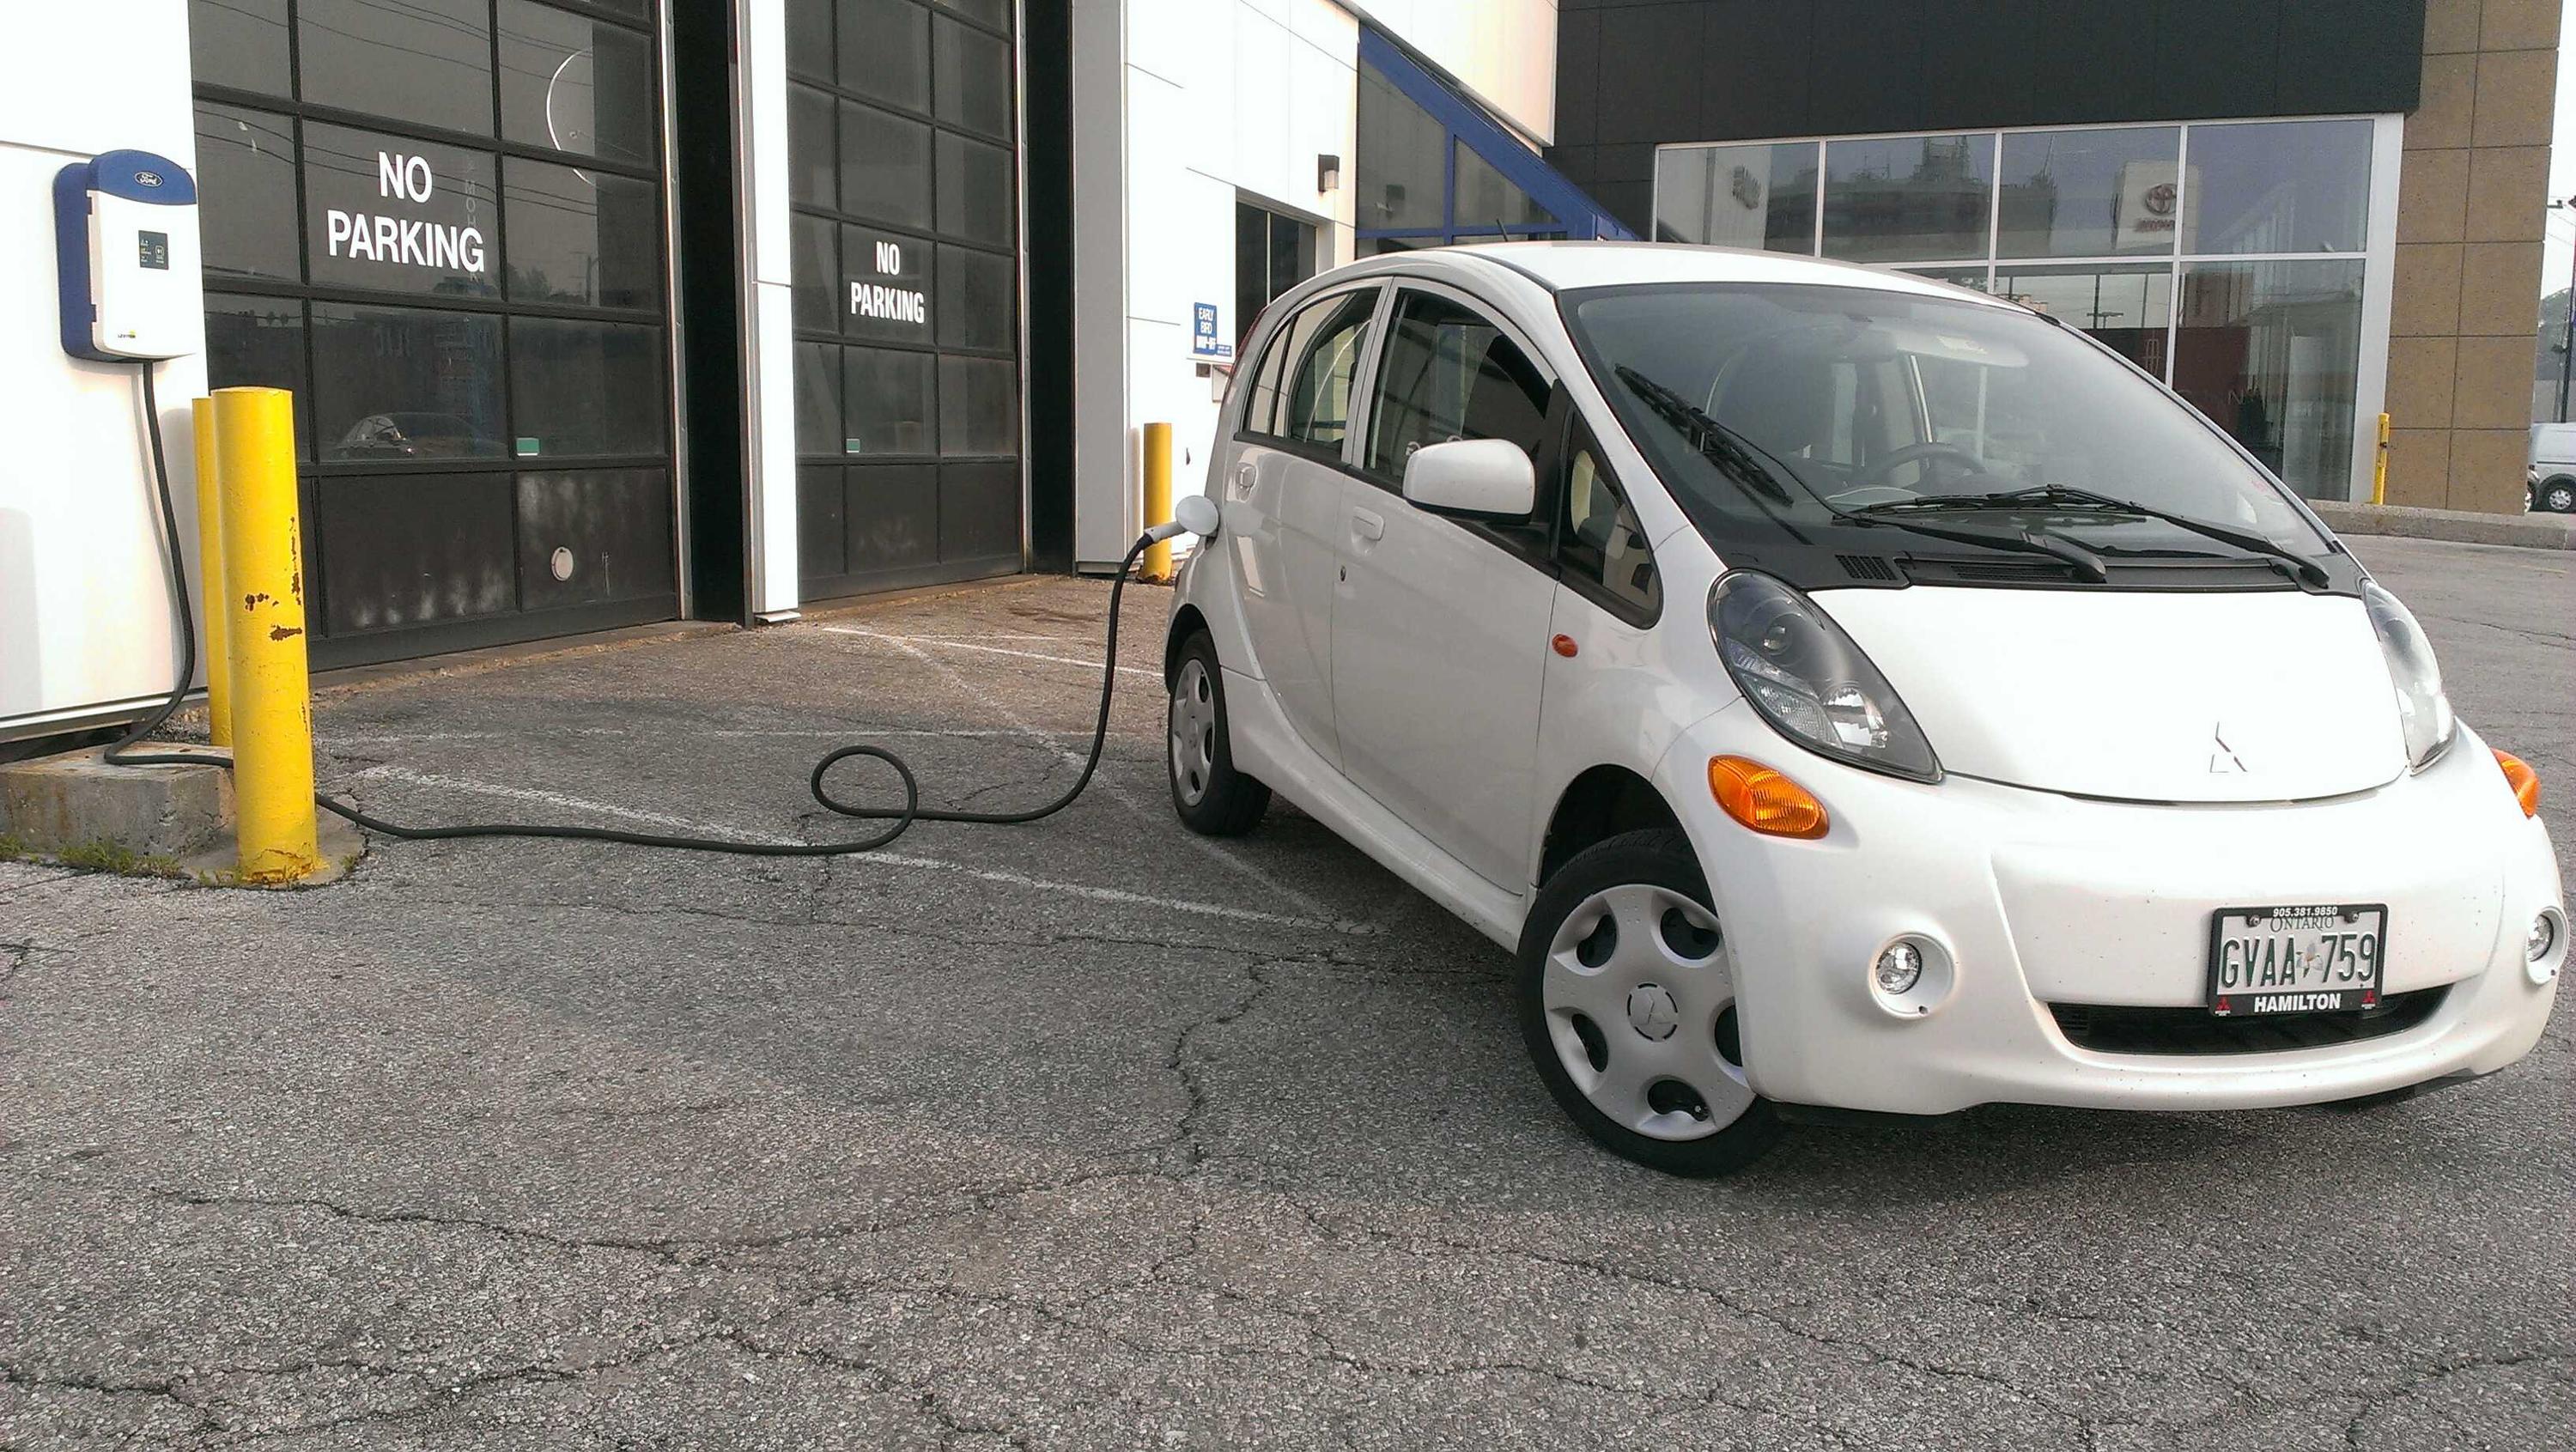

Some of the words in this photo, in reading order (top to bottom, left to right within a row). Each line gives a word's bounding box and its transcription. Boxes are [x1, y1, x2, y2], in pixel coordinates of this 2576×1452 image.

[379, 151, 433, 203] NO
[327, 210, 484, 272] PARKING
[876, 240, 900, 276] NO
[851, 282, 925, 324] PARKING
[2270, 916, 2334, 933] ONTARIO
[2273, 907, 2338, 917] 905.381.9850
[2221, 933, 2296, 988] GVAA
[2321, 931, 2377, 983] 759
[2254, 993, 2341, 1013] HAMILTON
